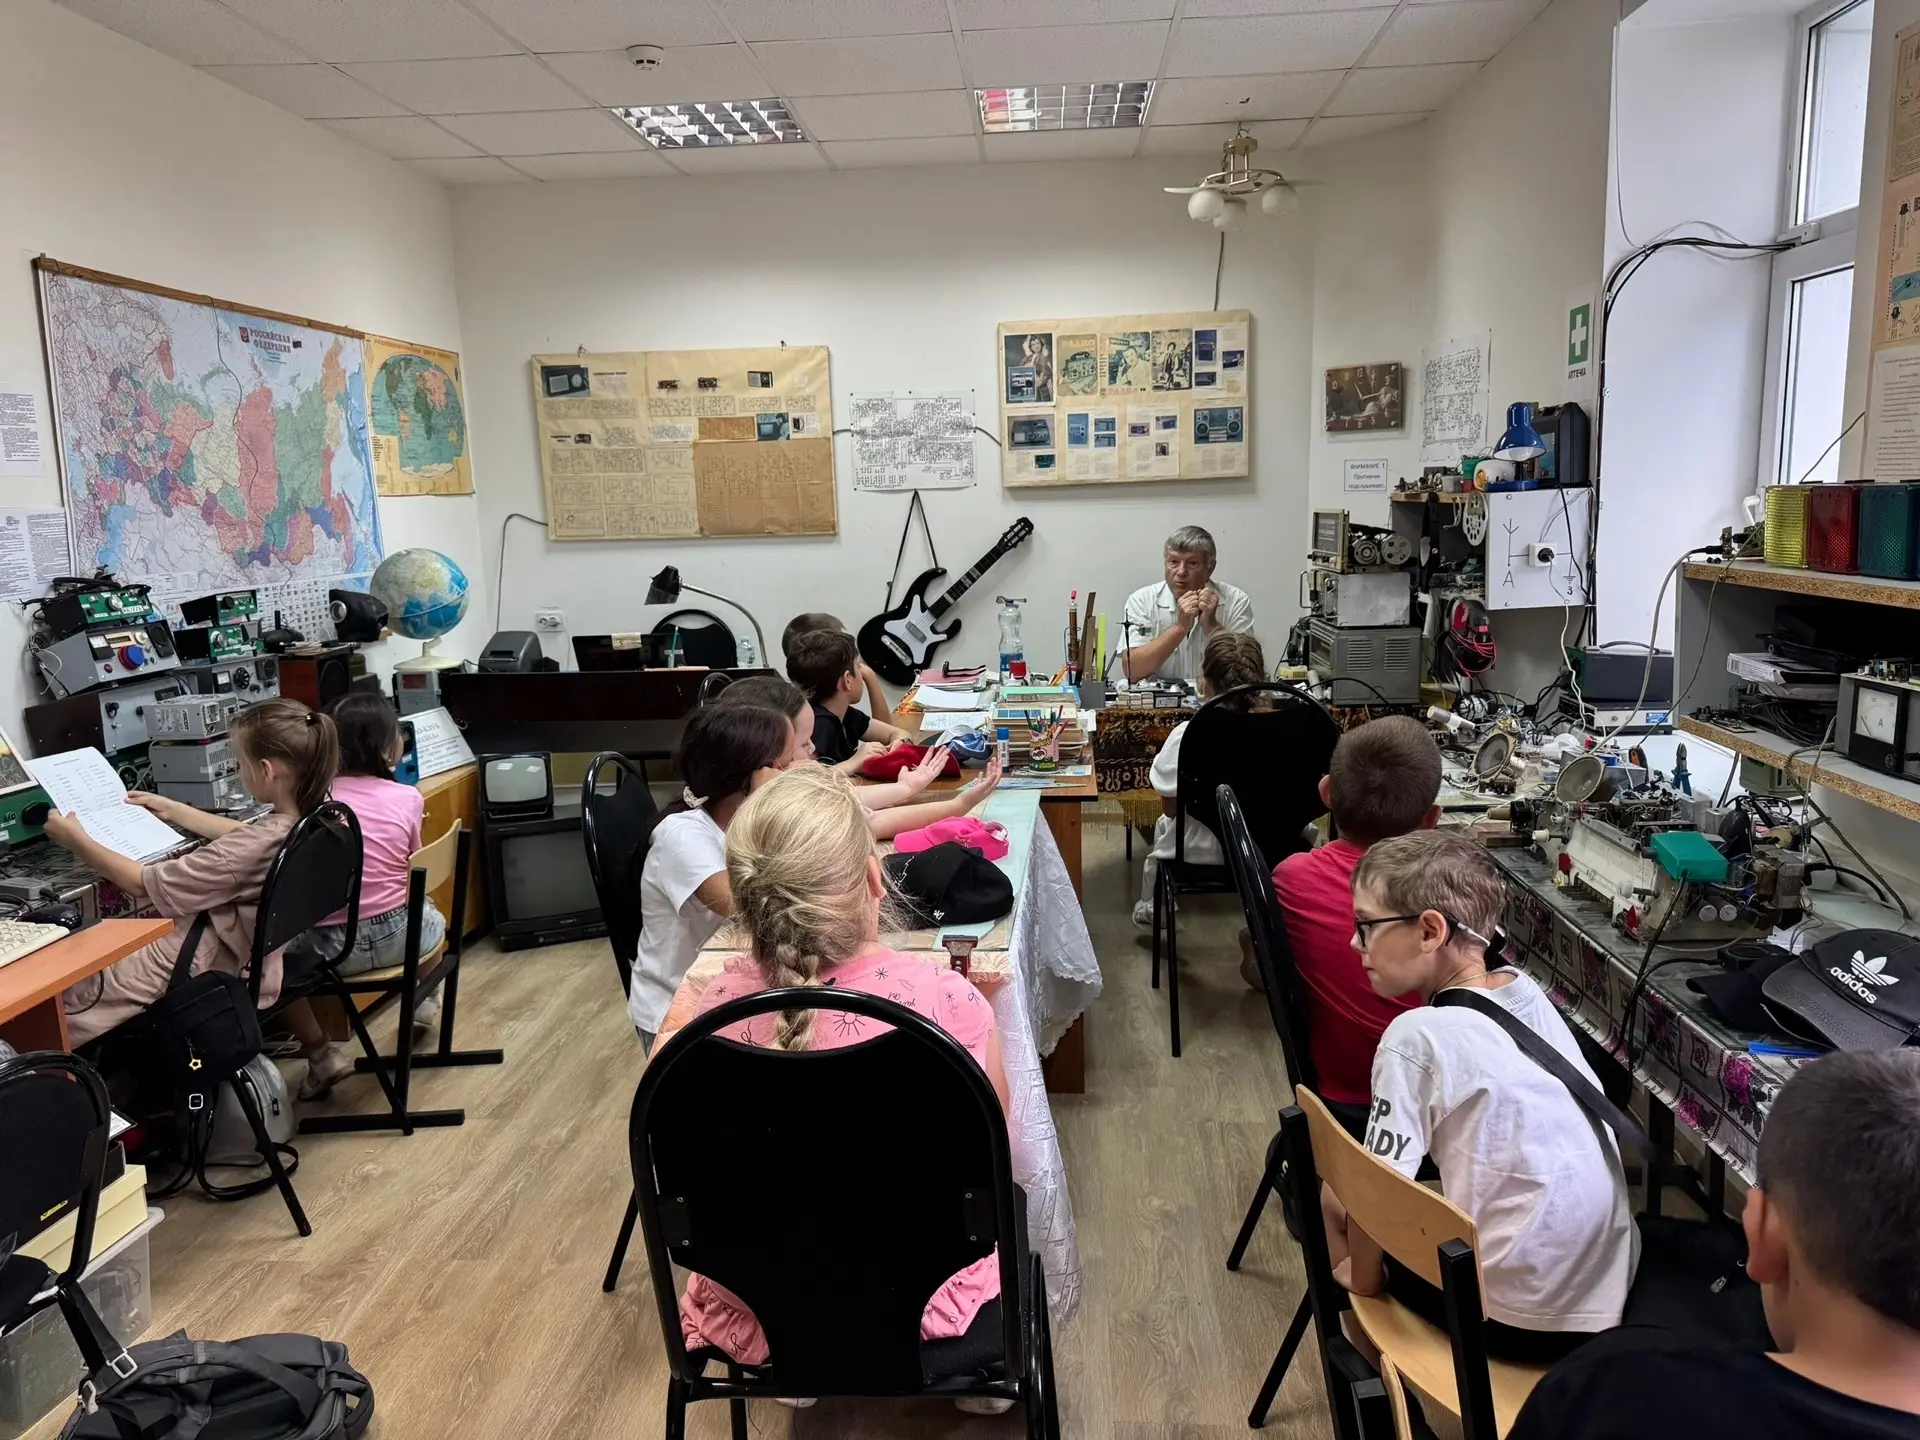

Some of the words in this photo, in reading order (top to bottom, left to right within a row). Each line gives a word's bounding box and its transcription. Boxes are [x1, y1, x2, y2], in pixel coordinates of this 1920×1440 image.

[250, 328, 291, 343] РОССИЙСКАЯ
[253, 339, 291, 353] ФЕДЕРАЦИЯ
[1357, 368, 1363, 378] 12
[1829, 966, 1877, 1004] adidas
